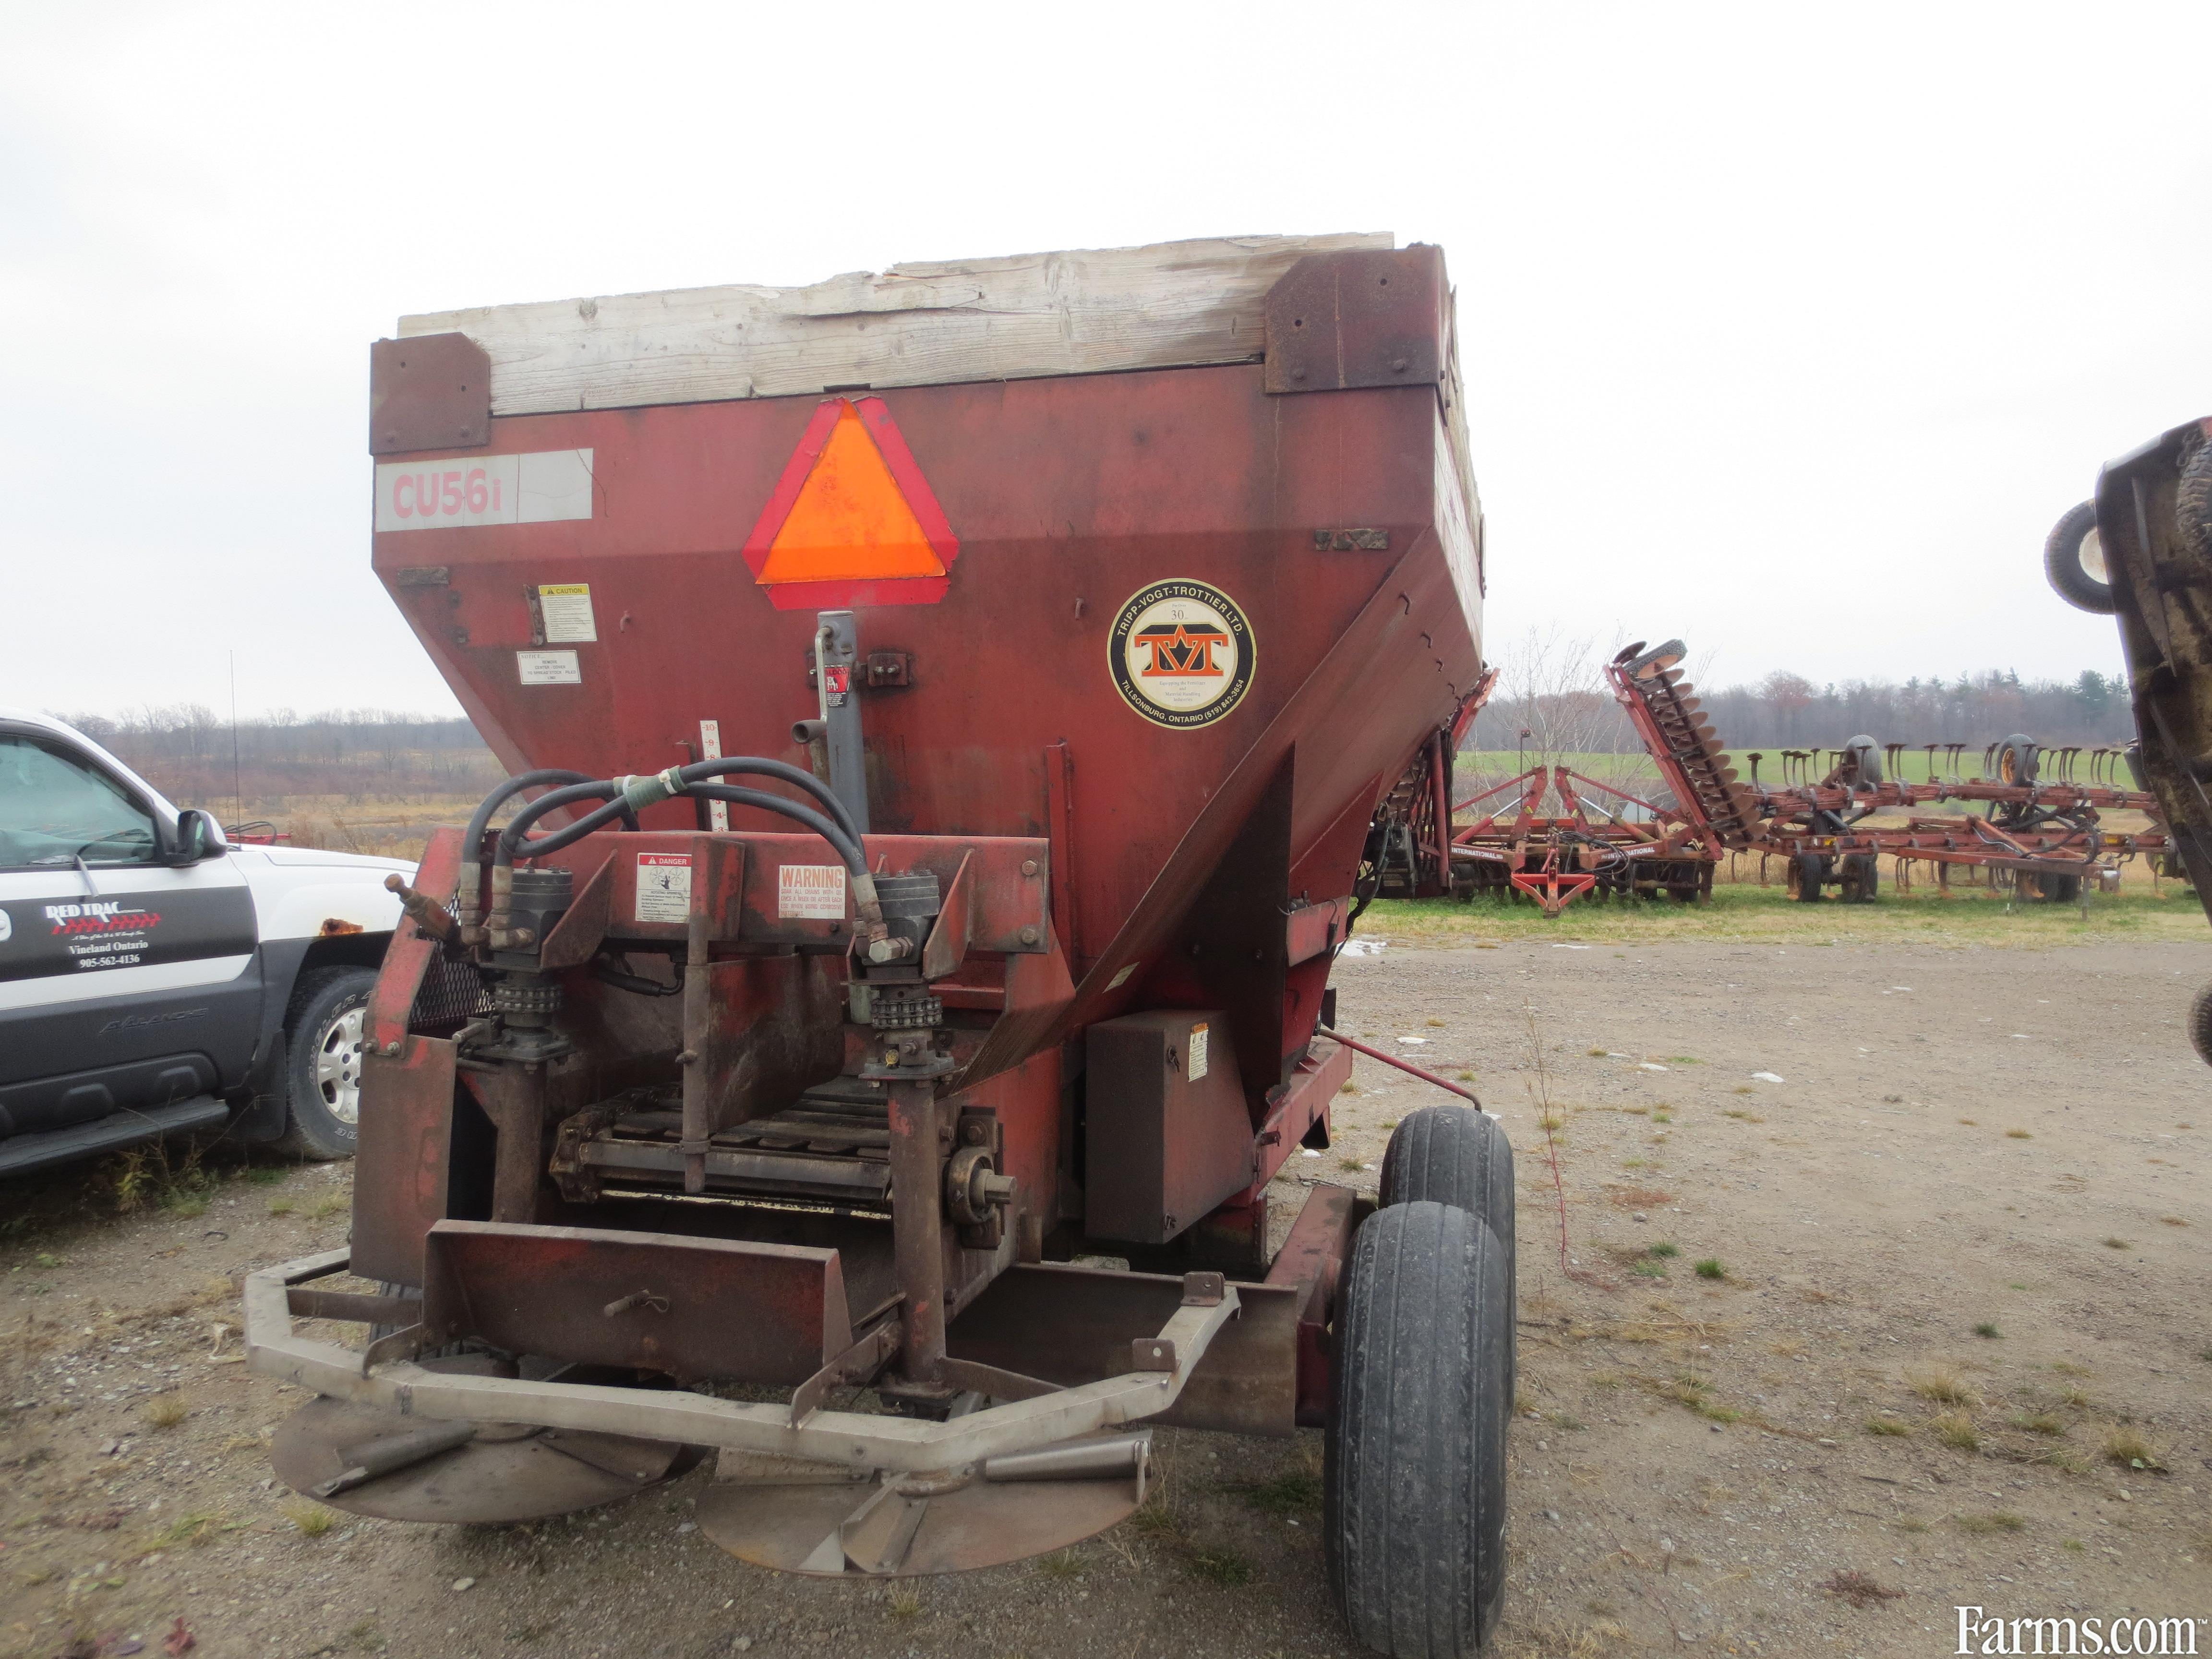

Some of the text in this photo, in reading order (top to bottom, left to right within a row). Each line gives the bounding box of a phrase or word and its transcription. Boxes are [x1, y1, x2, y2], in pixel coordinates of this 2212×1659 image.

[393, 469, 501, 518] CU56i
[1117, 586, 1243, 637] TRIPP-VOGT-TROTTIER LTD.
[1171, 610, 1184, 620] 30
[1122, 679, 1244, 723] TILLSONBURG, ONTARIO (519) 842-3654
[1452, 847, 1497, 859] INTERNATIONAL
[781, 868, 842, 888] WARNING
[46, 902, 120, 926] RED TRAC
[69, 940, 148, 954] Vineland Ontario
[80, 954, 140, 969] 905-562-4136
